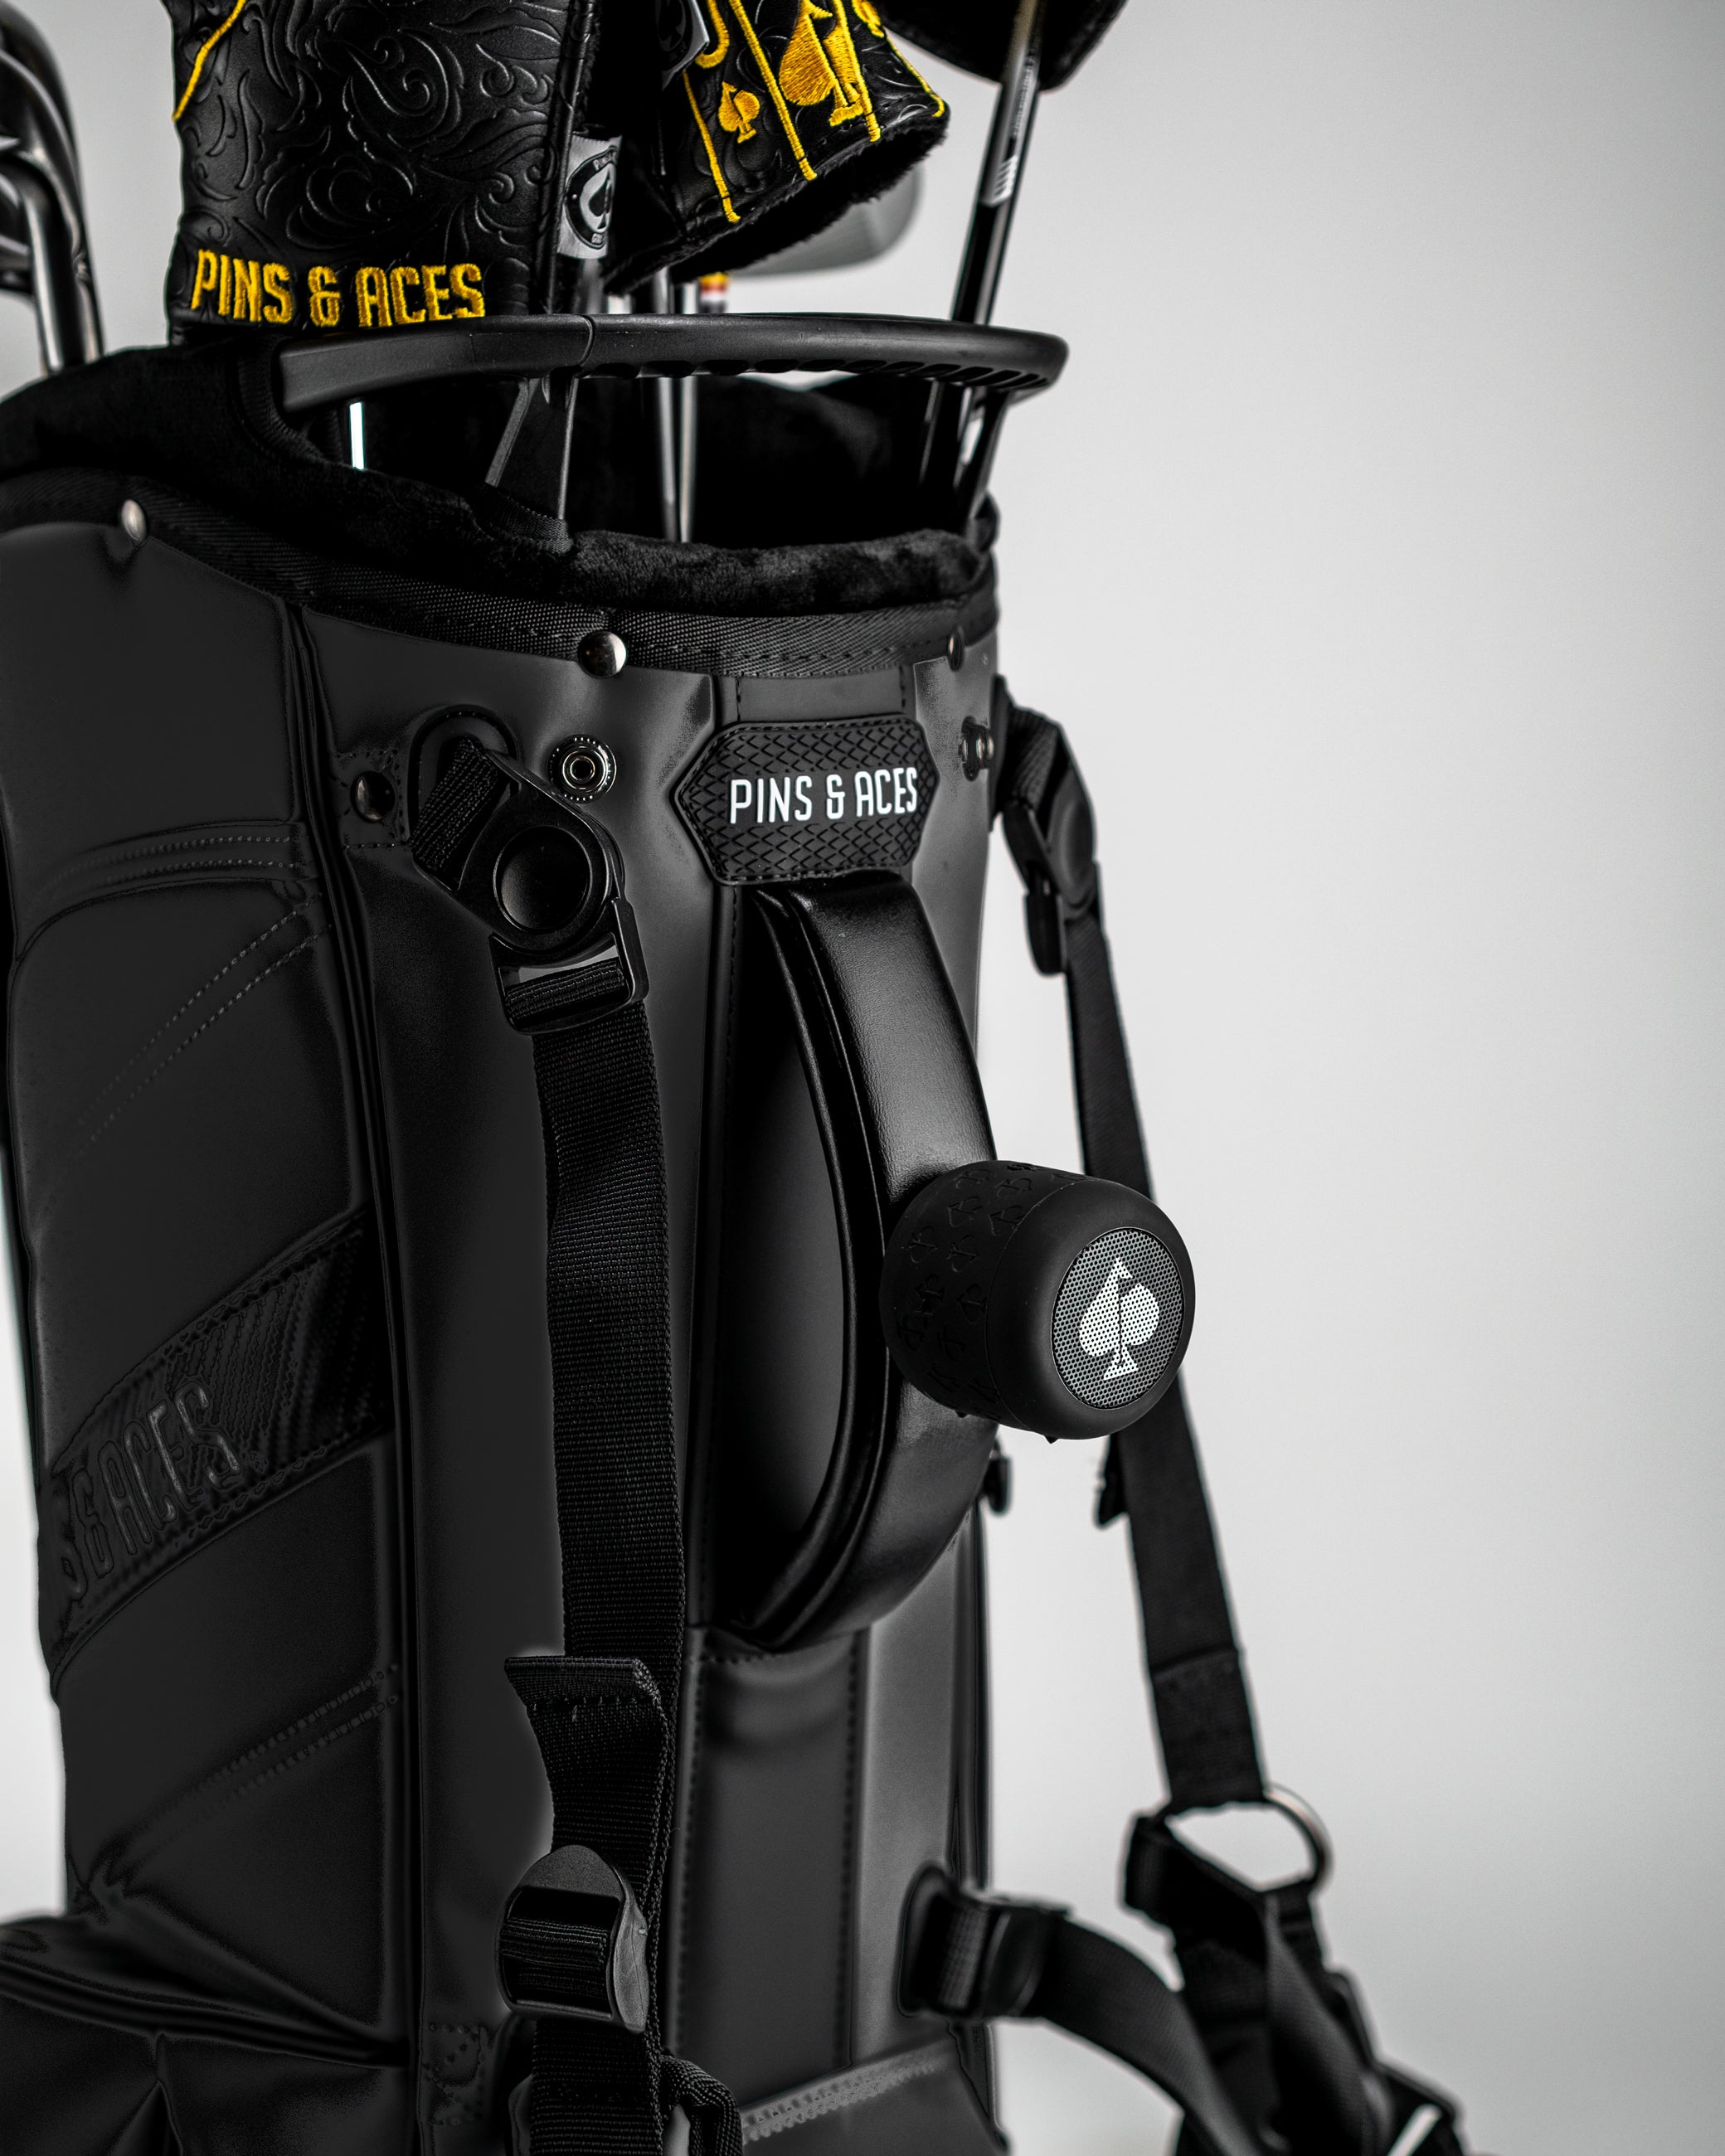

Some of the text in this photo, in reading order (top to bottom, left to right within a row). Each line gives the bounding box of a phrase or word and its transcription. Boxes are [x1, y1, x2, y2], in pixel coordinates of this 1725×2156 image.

[190, 249, 486, 328] PINS & ACES
[730, 766, 917, 825] PINS & ACES
[97, 1381, 241, 1556] ACES
